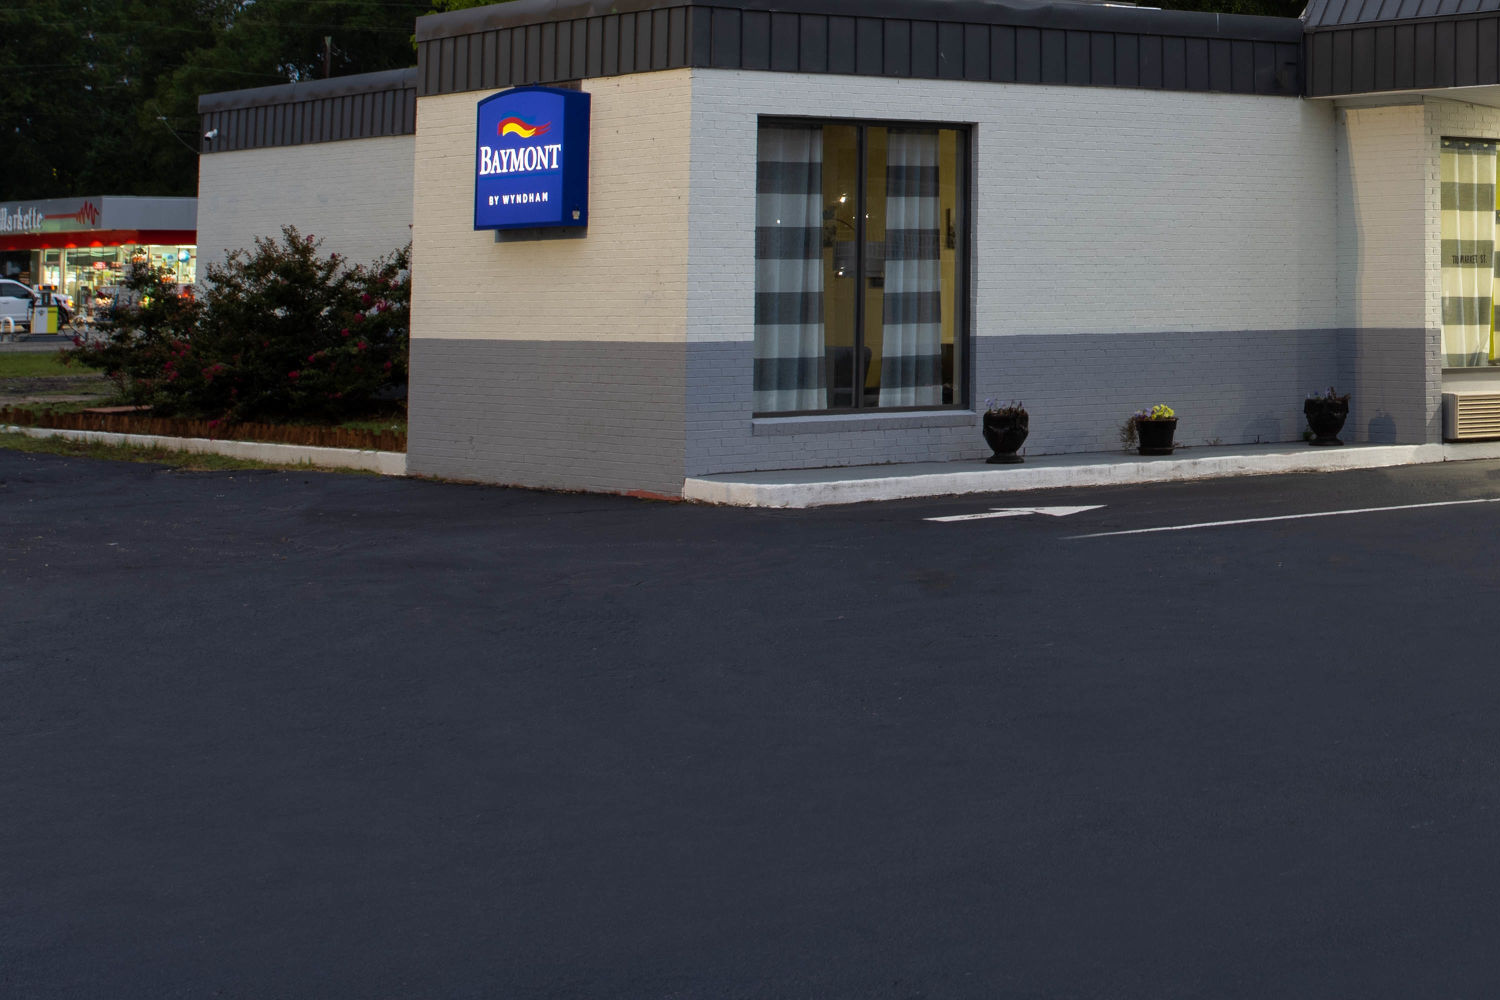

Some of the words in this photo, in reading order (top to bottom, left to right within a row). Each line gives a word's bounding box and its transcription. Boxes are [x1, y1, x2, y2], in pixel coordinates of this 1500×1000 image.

[479, 144, 562, 176] BAYMONT
[488, 195, 500, 206] BY
[502, 192, 549, 205] WYNDHAM
